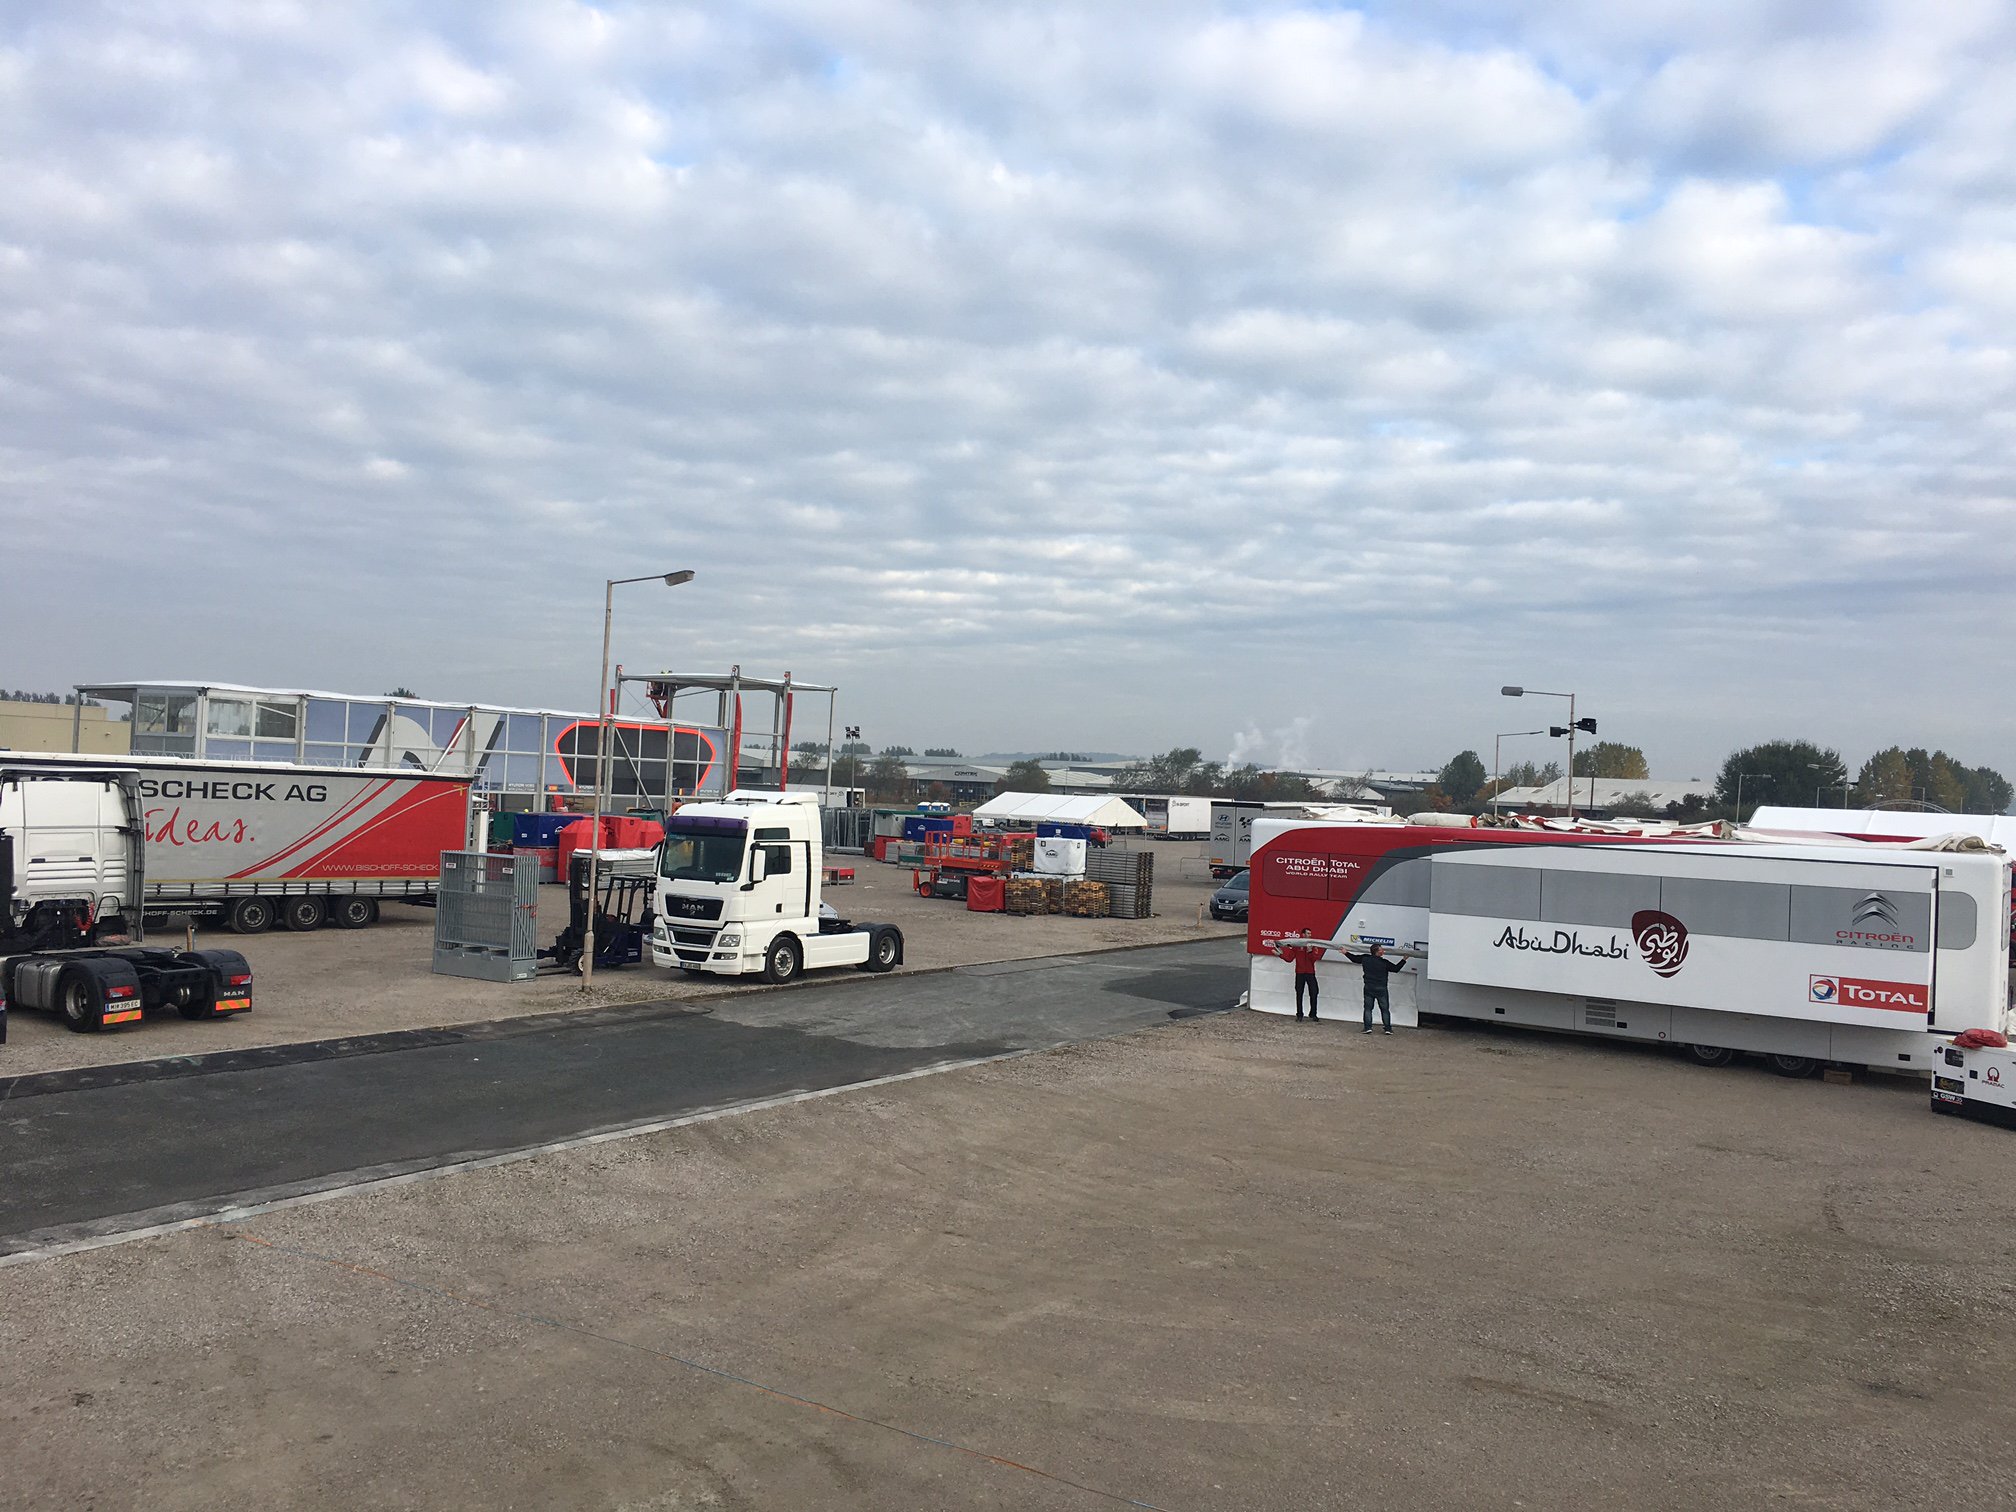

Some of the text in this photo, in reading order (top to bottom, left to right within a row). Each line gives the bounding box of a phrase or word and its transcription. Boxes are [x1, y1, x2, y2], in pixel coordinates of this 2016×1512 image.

[138, 779, 328, 802] SCHECK AG
[1286, 864, 1348, 874] ABU DHABI
[681, 903, 705, 911] MAN
[1836, 939, 1914, 950] RACING
